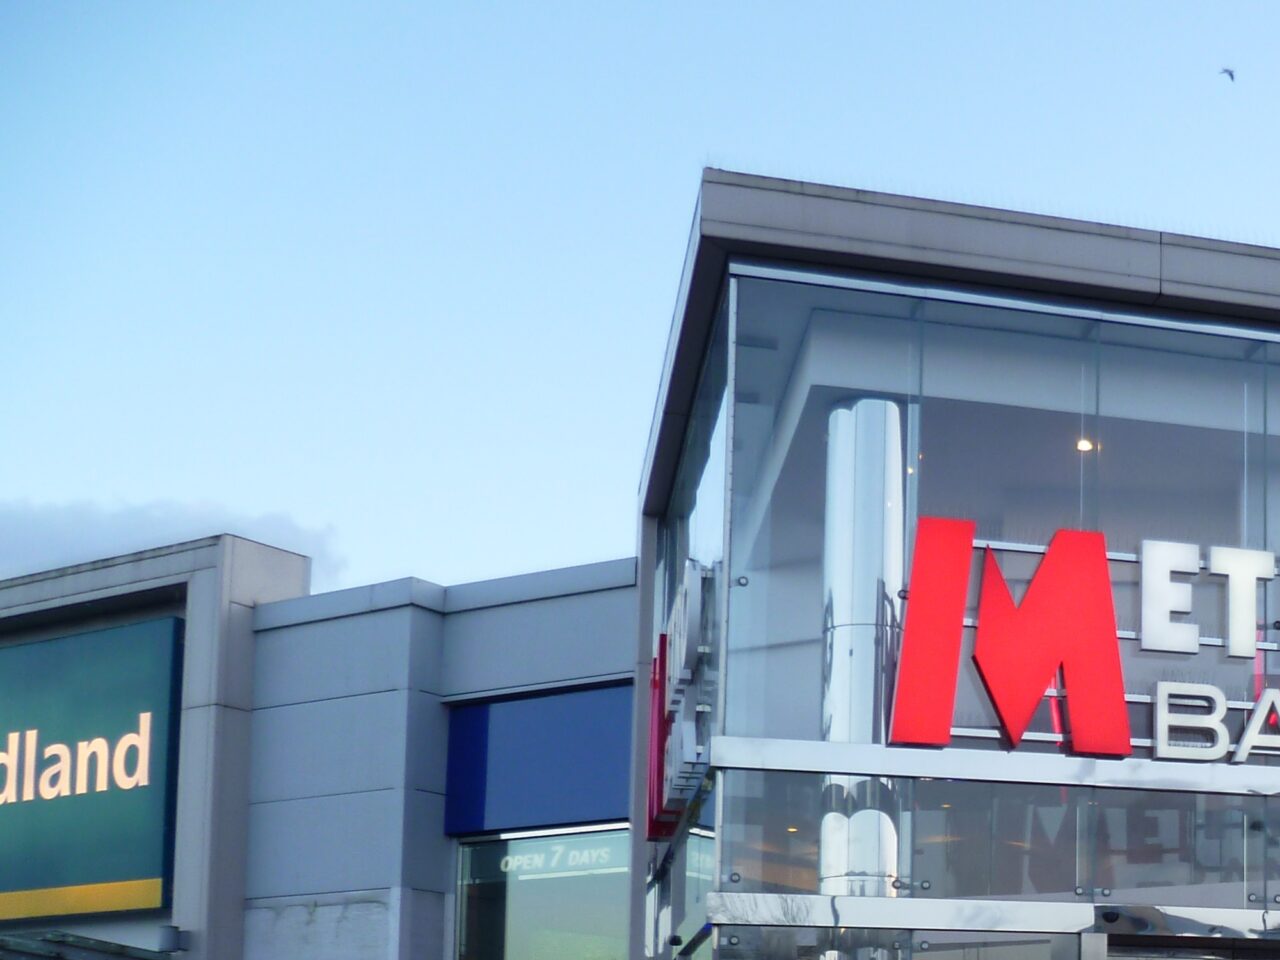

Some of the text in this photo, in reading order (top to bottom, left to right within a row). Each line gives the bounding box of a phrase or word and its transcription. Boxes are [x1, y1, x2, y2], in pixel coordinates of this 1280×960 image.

[500, 845, 611, 872] OPEN 7 DAYS
